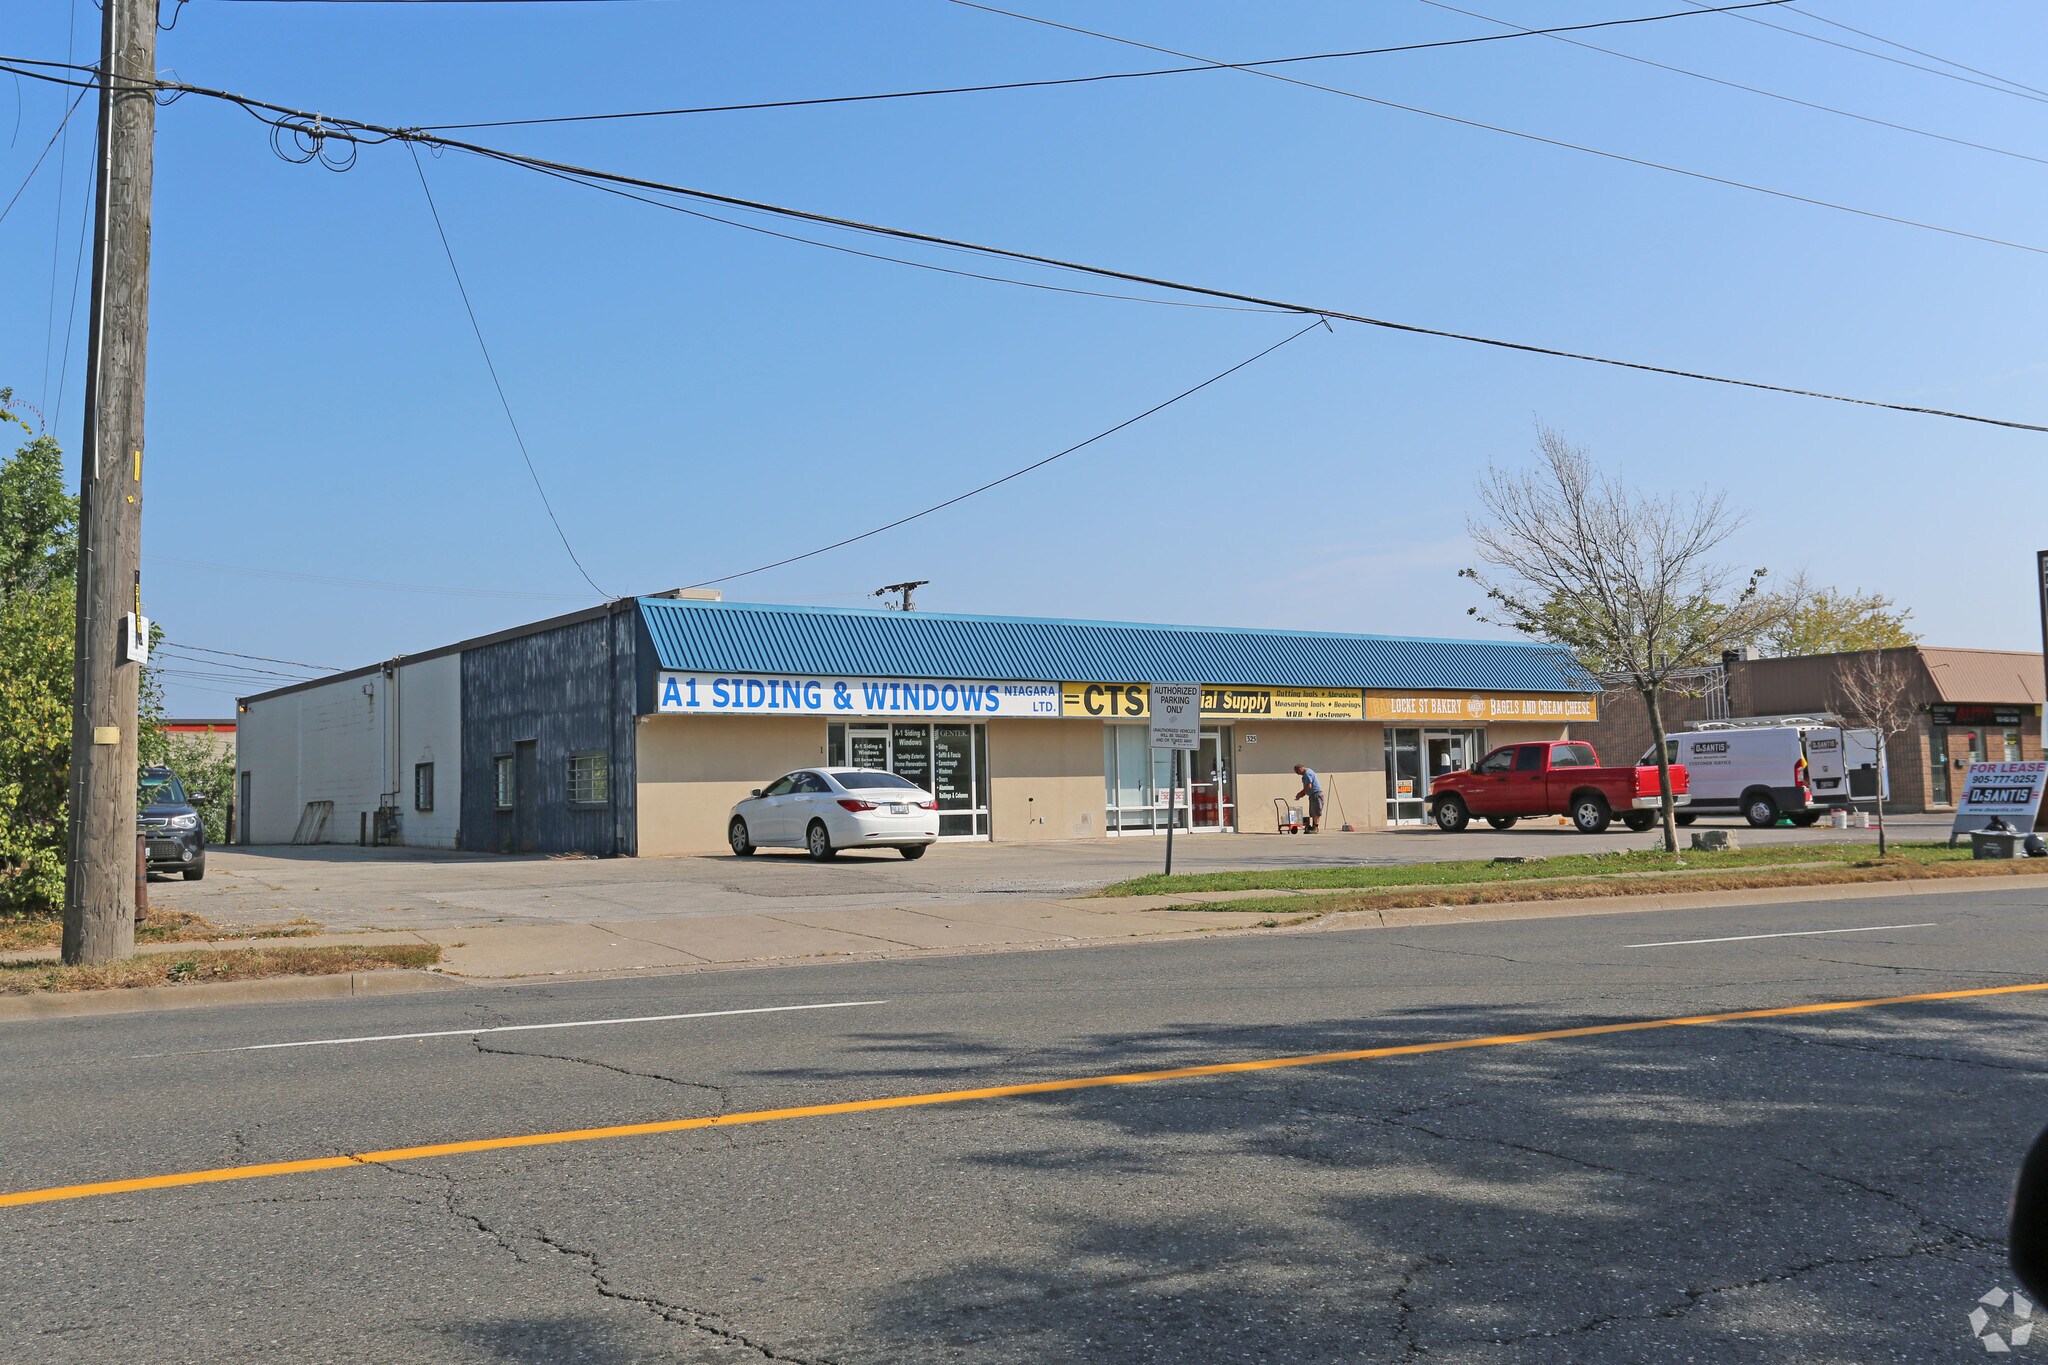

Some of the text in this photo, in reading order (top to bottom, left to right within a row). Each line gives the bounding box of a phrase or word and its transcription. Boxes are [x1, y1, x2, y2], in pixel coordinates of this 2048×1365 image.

[662, 677, 1000, 712] A1 SIDING & WINDOWS
[1004, 685, 1056, 697] NIAGARA
[1154, 686, 1197, 695] AUTHORIZED
[1276, 689, 1301, 698] Cutting
[1328, 690, 1359, 698] Abrasives
[1160, 696, 1190, 704] PARKING
[1223, 691, 1269, 713] Supply
[1274, 700, 1309, 708] Measuring
[1334, 701, 1361, 709] Bearings
[1032, 701, 1056, 712] LTD.
[1166, 705, 1184, 713] ONLY
[1391, 698, 1462, 714] LOCKE ST BAKERY
[904, 729, 920, 738] Siding
[1969, 763, 2046, 773] FOR LEASE
[1972, 775, 2037, 783] 905-777-0252
